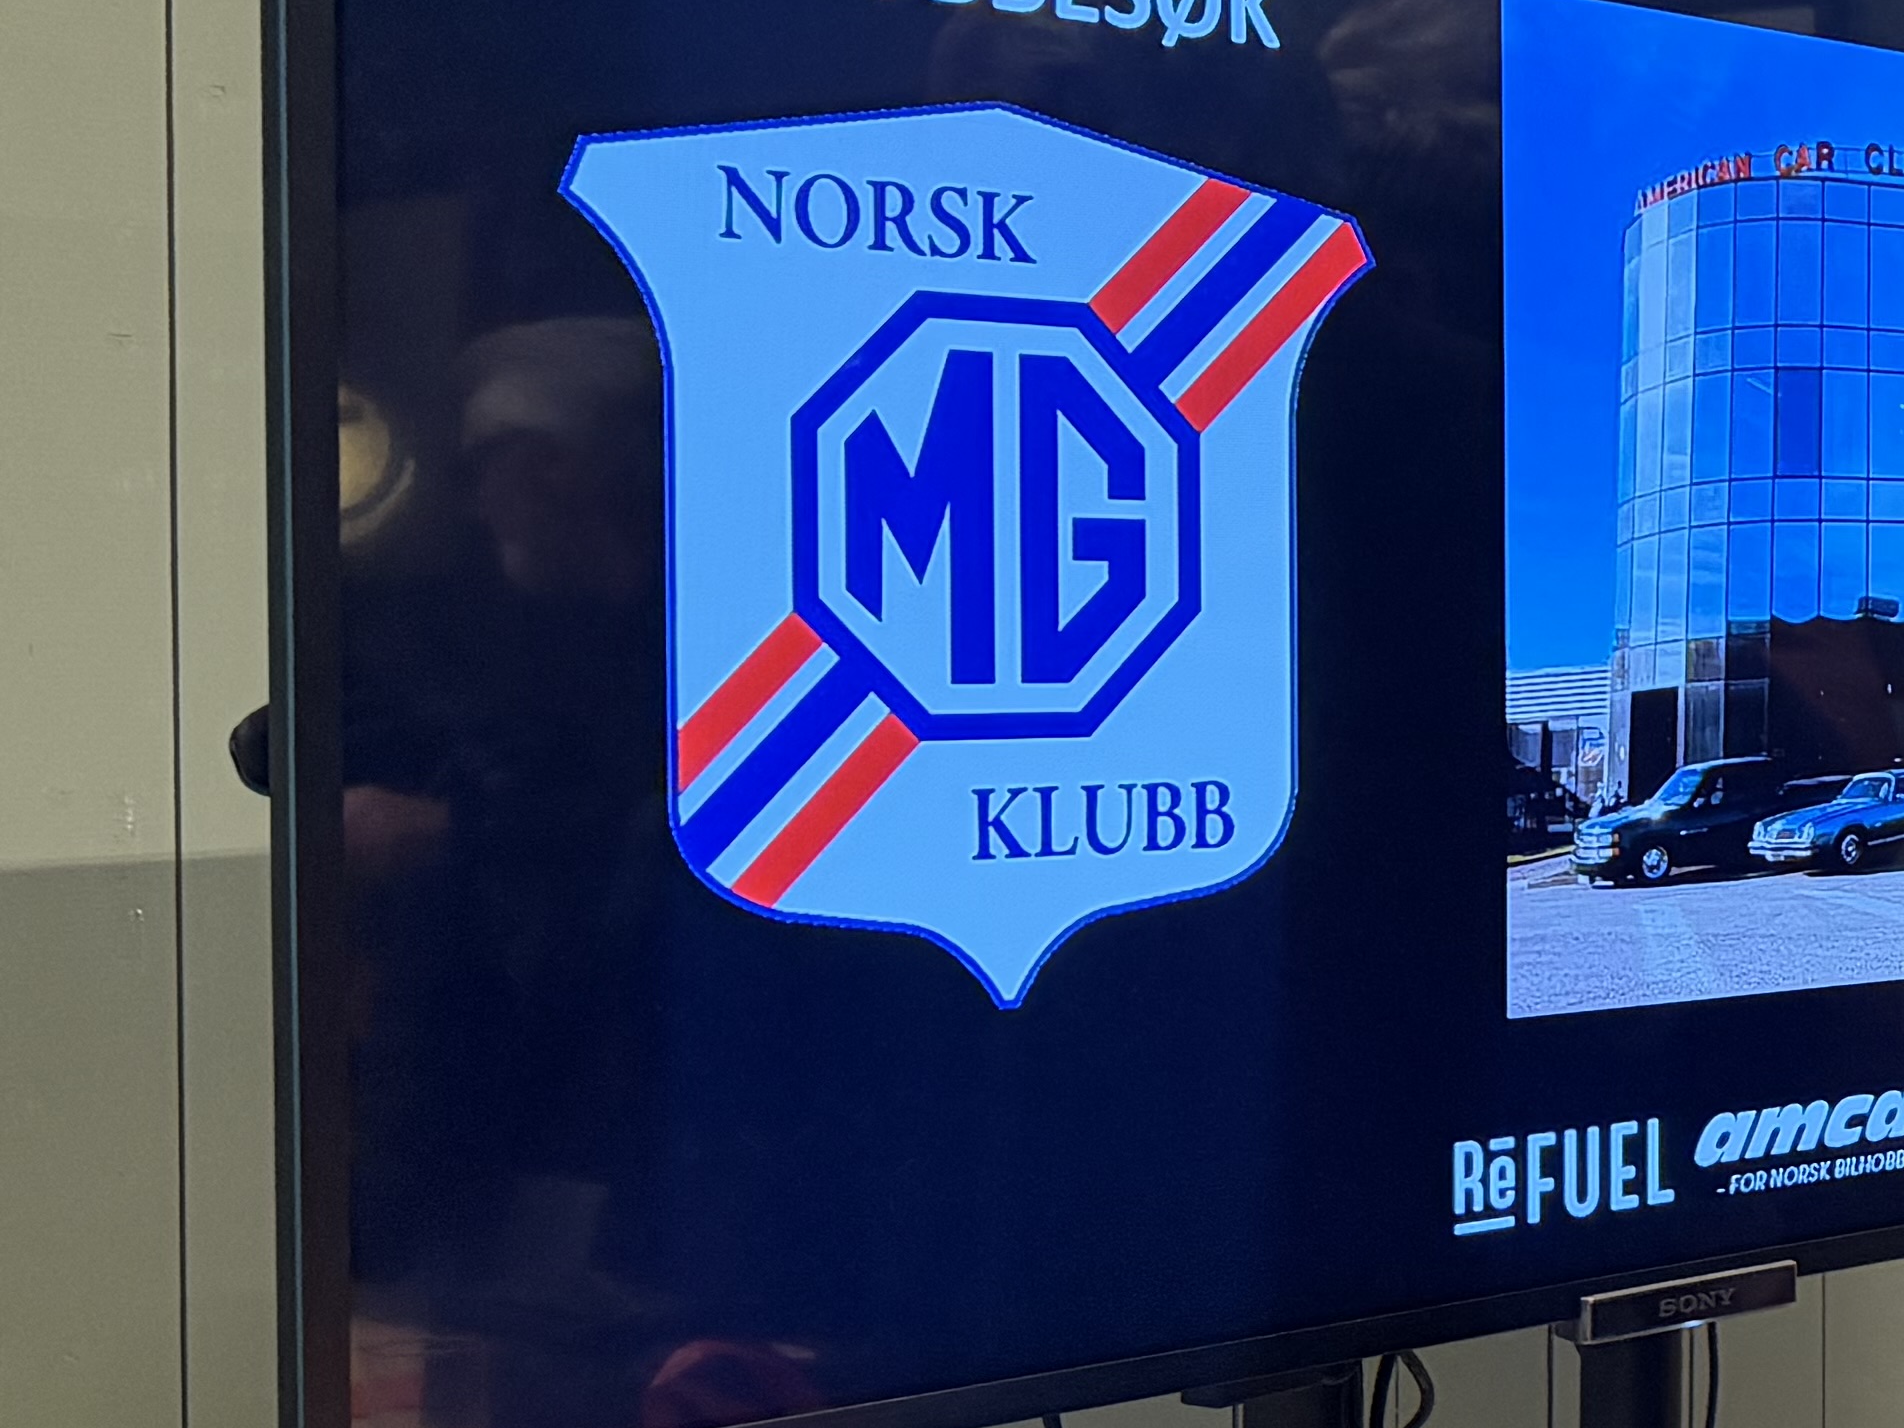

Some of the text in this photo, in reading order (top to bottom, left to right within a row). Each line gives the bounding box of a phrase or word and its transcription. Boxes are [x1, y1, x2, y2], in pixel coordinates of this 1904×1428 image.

[716, 165, 1037, 264] NORSK
[1634, 152, 1752, 216] AMERICAN
[1774, 140, 1835, 177] CAR
[845, 349, 1146, 684] MG
[970, 778, 1236, 860] KLUBB
[1729, 1172, 1767, 1195] FOR
[1770, 1160, 1831, 1189] NORSK
[1658, 1288, 1736, 1317] SONY
